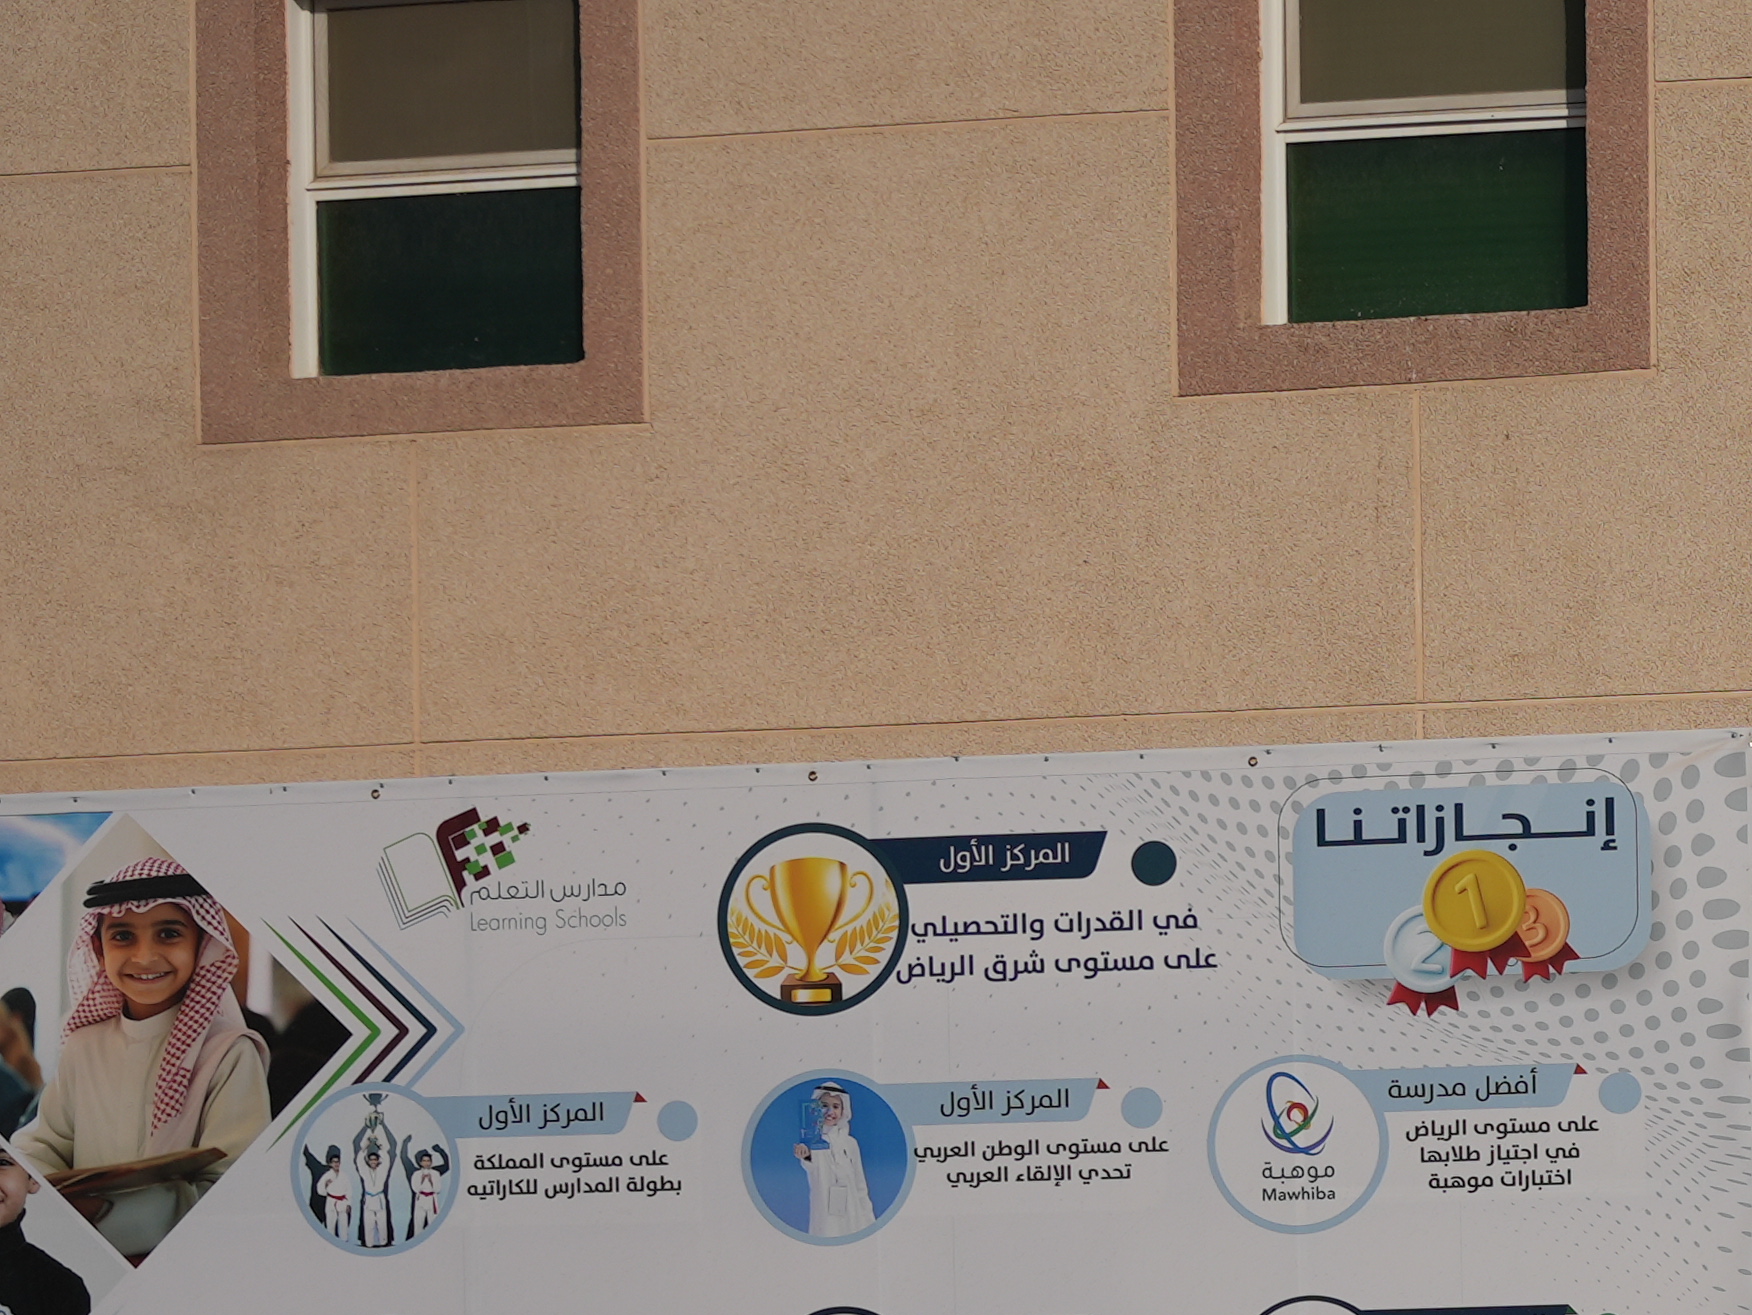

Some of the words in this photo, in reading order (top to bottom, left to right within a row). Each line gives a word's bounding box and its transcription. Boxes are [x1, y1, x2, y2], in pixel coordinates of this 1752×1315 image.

[940, 839, 993, 873] الأول
[1000, 843, 1070, 866] المركز
[469, 877, 543, 904] التعلم
[551, 879, 626, 902] مدارس
[470, 910, 547, 934] Learning
[555, 908, 626, 929] Schools
[910, 914, 1046, 939] والتحصيلي
[1053, 909, 1142, 937] القدرات
[1153, 908, 1198, 934] في
[896, 956, 977, 983] الرياض
[985, 950, 1045, 981] شرق
[1055, 953, 1154, 978] مستوى
[1164, 949, 1218, 968] على
[1388, 1079, 1466, 1104] مدرسة
[1475, 1068, 1537, 1101] أفضل
[940, 1085, 993, 1117] الأول
[1002, 1089, 1069, 1114] المركز
[1405, 1120, 1466, 1142] الرياض
[1474, 1119, 1551, 1139] مستوى
[1558, 1116, 1599, 1132] على
[913, 1142, 975, 1162] العربي
[983, 1139, 1039, 1160] الوطن
[1053, 1140, 1122, 1159] مستوى
[1128, 1138, 1169, 1153] على
[1420, 1145, 1480, 1165] طلابها
[1487, 1144, 1538, 1166] اجتياز
[1545, 1143, 1580, 1161] في
[946, 1166, 1007, 1188] العربي
[1016, 1166, 1071, 1186] الإلقاء
[1078, 1163, 1132, 1184] تحدي
[1262, 1162, 1335, 1182] موهبة
[1428, 1173, 1493, 1193] موهبة
[1500, 1170, 1572, 1192] اختبارات
[1262, 1187, 1336, 1201] Mawhiba
